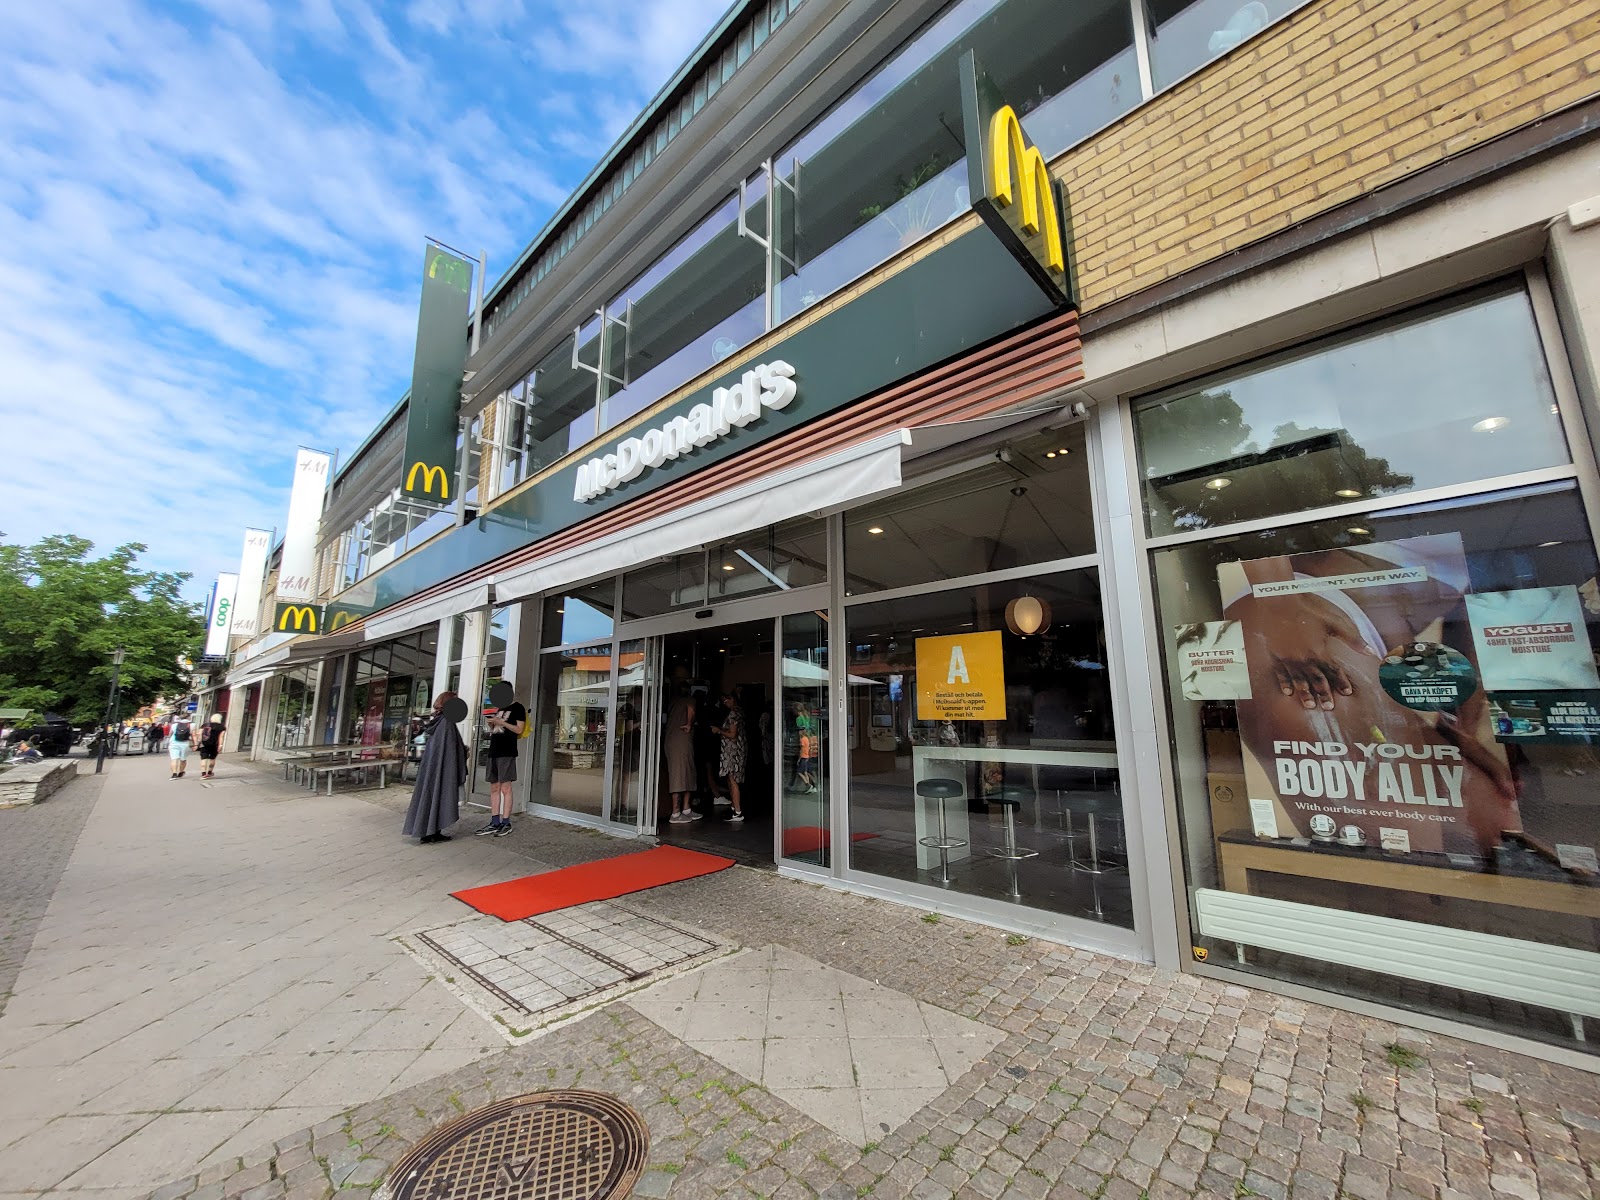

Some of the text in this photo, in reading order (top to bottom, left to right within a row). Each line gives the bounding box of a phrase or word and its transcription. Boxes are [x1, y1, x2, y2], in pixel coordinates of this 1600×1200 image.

[573, 359, 797, 503] McDonald's
[1258, 584, 1290, 594] YOUR
[1349, 574, 1386, 585] YOUR
[1388, 571, 1422, 581] WAY.
[216, 597, 231, 628] coop
[1486, 624, 1569, 636] YOGURT
[1508, 635, 1576, 645] FAST-ABSORBING
[1188, 649, 1235, 658] BUTTER
[1511, 644, 1552, 654] MOISTURE
[947, 645, 970, 684] A
[1273, 740, 1462, 761] FIND YOUR
[1275, 757, 1464, 808] BODY ALLY
[1295, 801, 1456, 823] With our best ever body care
